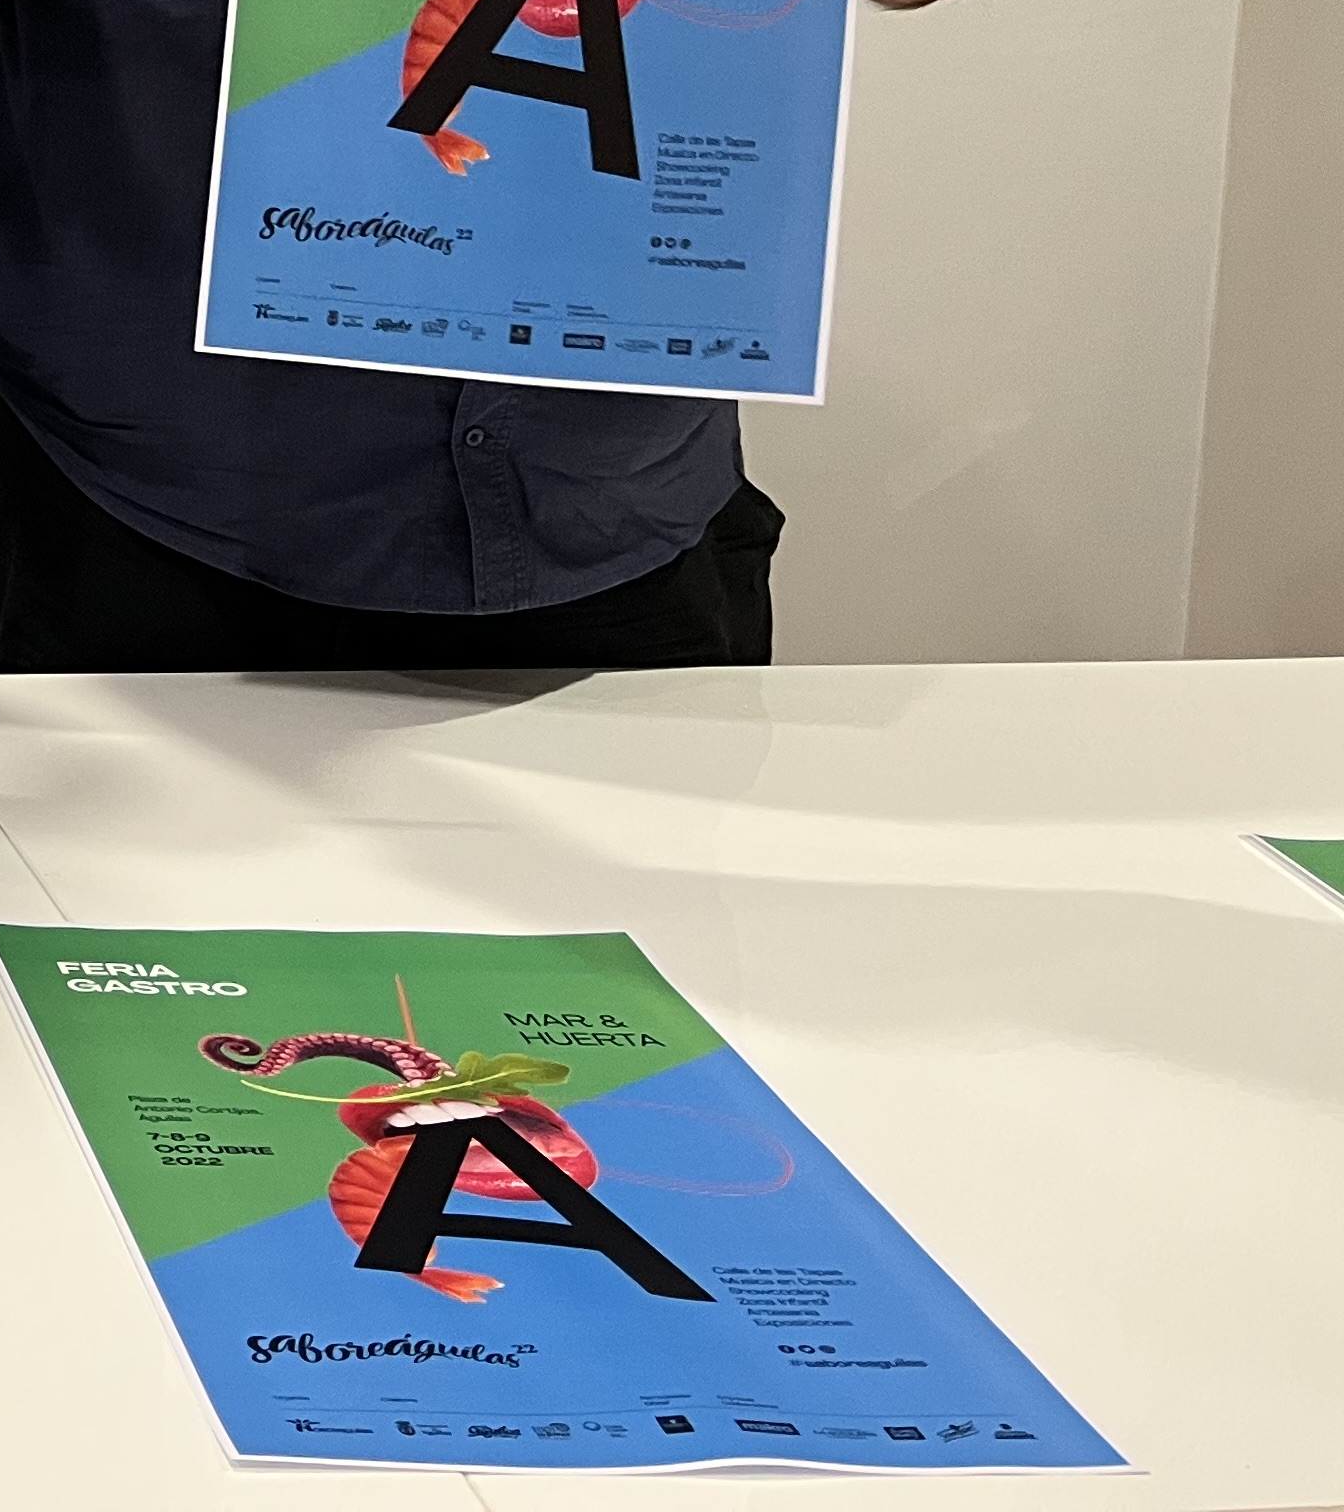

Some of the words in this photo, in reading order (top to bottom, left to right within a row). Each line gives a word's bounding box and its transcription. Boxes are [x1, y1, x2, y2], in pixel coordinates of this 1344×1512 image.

[56, 961, 180, 978] FERIA
[66, 979, 247, 998] GASTRO
[503, 1011, 593, 1029] MAR
[599, 1012, 629, 1029] &
[521, 1028, 667, 1048] HUERTA
[160, 1156, 225, 1167] 2022
